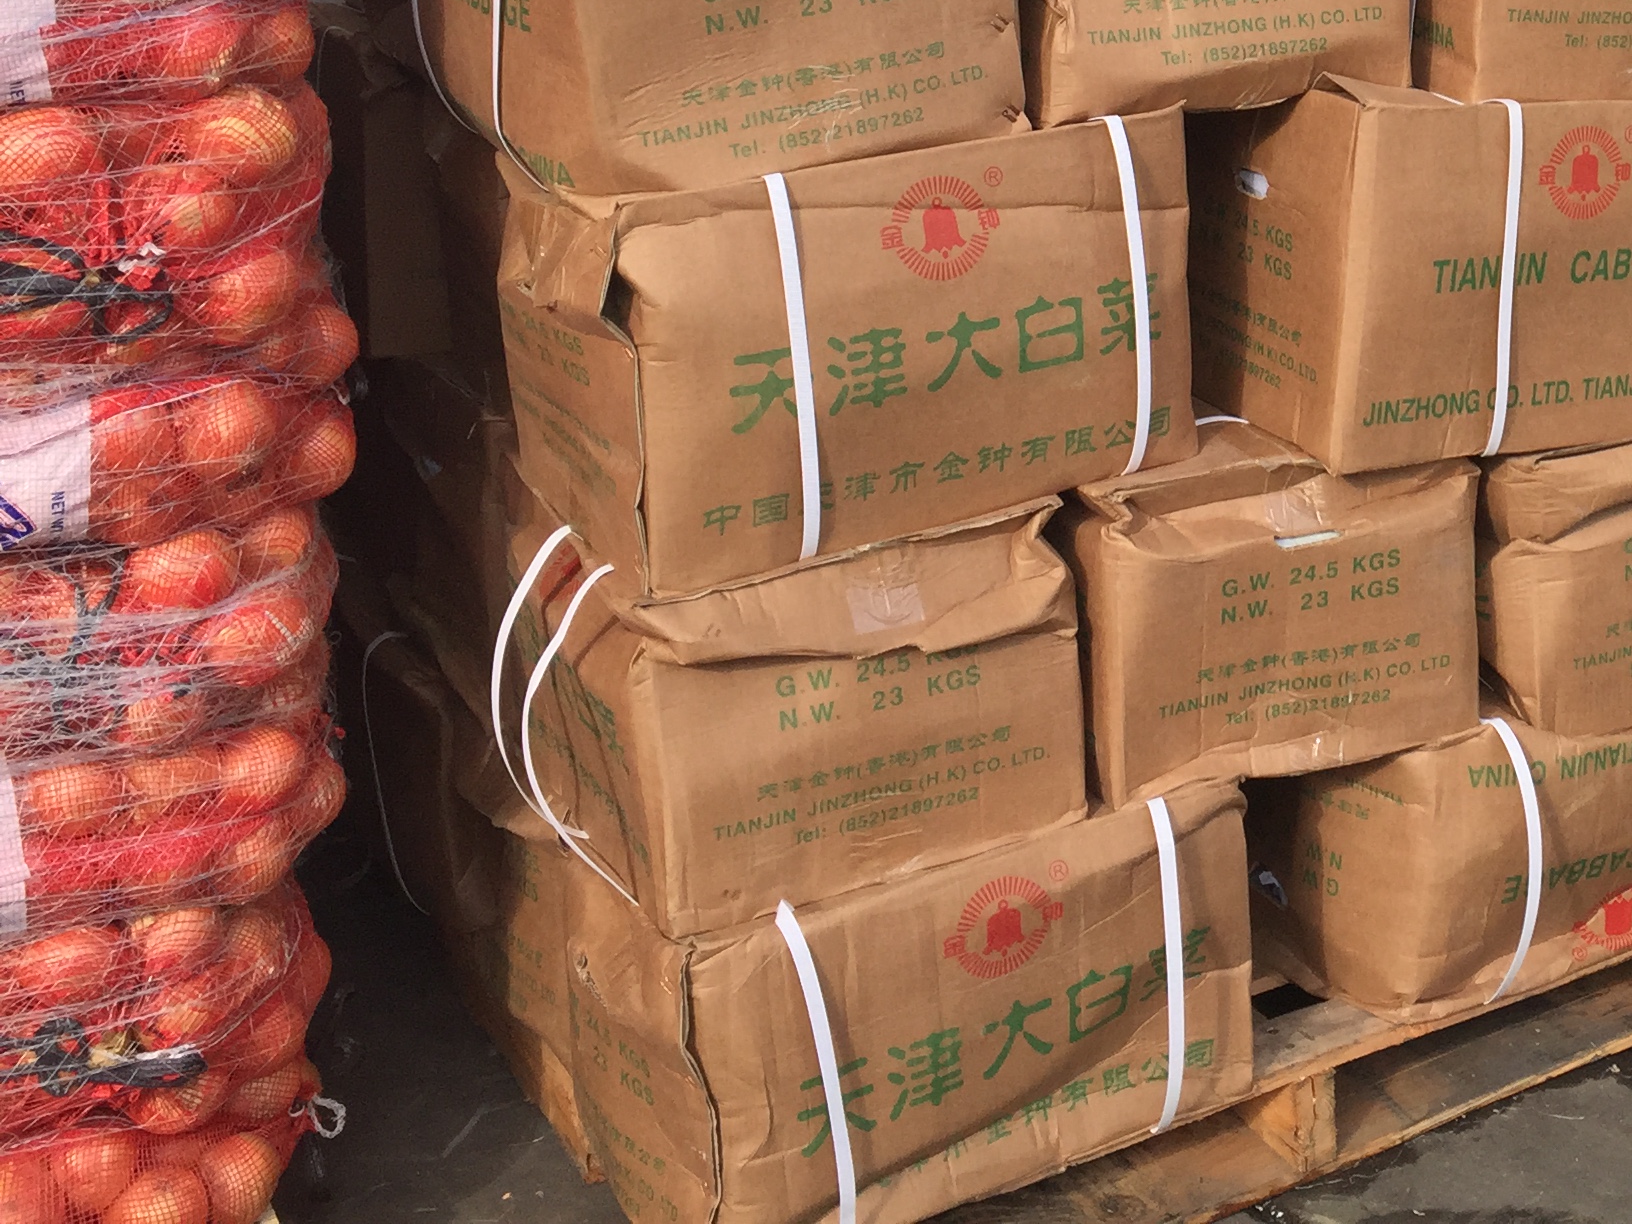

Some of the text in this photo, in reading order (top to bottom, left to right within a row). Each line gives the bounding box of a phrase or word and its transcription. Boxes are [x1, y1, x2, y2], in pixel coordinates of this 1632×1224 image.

[705, 6, 769, 35] N.W.
[1088, 27, 1162, 45] TIANJIN
[1171, 17, 1267, 40] JINZHONG
[1273, 12, 1315, 33] (H.K)
[1321, 9, 1350, 25] CO.
[1508, 8, 1569, 25] TIANJIN
[1161, 37, 1327, 66] Tel: (852)21897262
[1564, 33, 1588, 48] Tel:
[637, 65, 988, 148] TIANJIN JINZHONG (H.K) CO. LTD.
[778, 107, 925, 154] (852)21897262
[1265, 224, 1294, 253] KGS
[1264, 253, 1293, 281] KGS
[1433, 251, 1548, 294] TIANIN
[729, 273, 1164, 435] 天津大白菜
[1362, 389, 1480, 427] JINZHONG
[1531, 379, 1575, 408] LTD.
[1222, 548, 1401, 598] G.W. 24.5 KGS
[1221, 577, 1400, 625] N.W. 23 KGS
[775, 667, 840, 699] G.W.
[856, 651, 911, 683] 24.5
[1573, 646, 1632, 670] TIANJIN
[779, 664, 981, 731] N.W. 23 KGS
[1159, 692, 1229, 719] TIANJIN
[1239, 675, 1332, 702] JINZHONG
[1338, 667, 1380, 687] (H.K)
[1386, 662, 1416, 678] CO.
[1265, 689, 1391, 722] (852)21897262
[713, 746, 1050, 842] TIANJIN JINZHONG (H.K) CO. LTD.
[837, 786, 979, 837] (852)21897262
[797, 926, 1211, 1158] 天津大白菜
[619, 1070, 655, 1106] KGS
